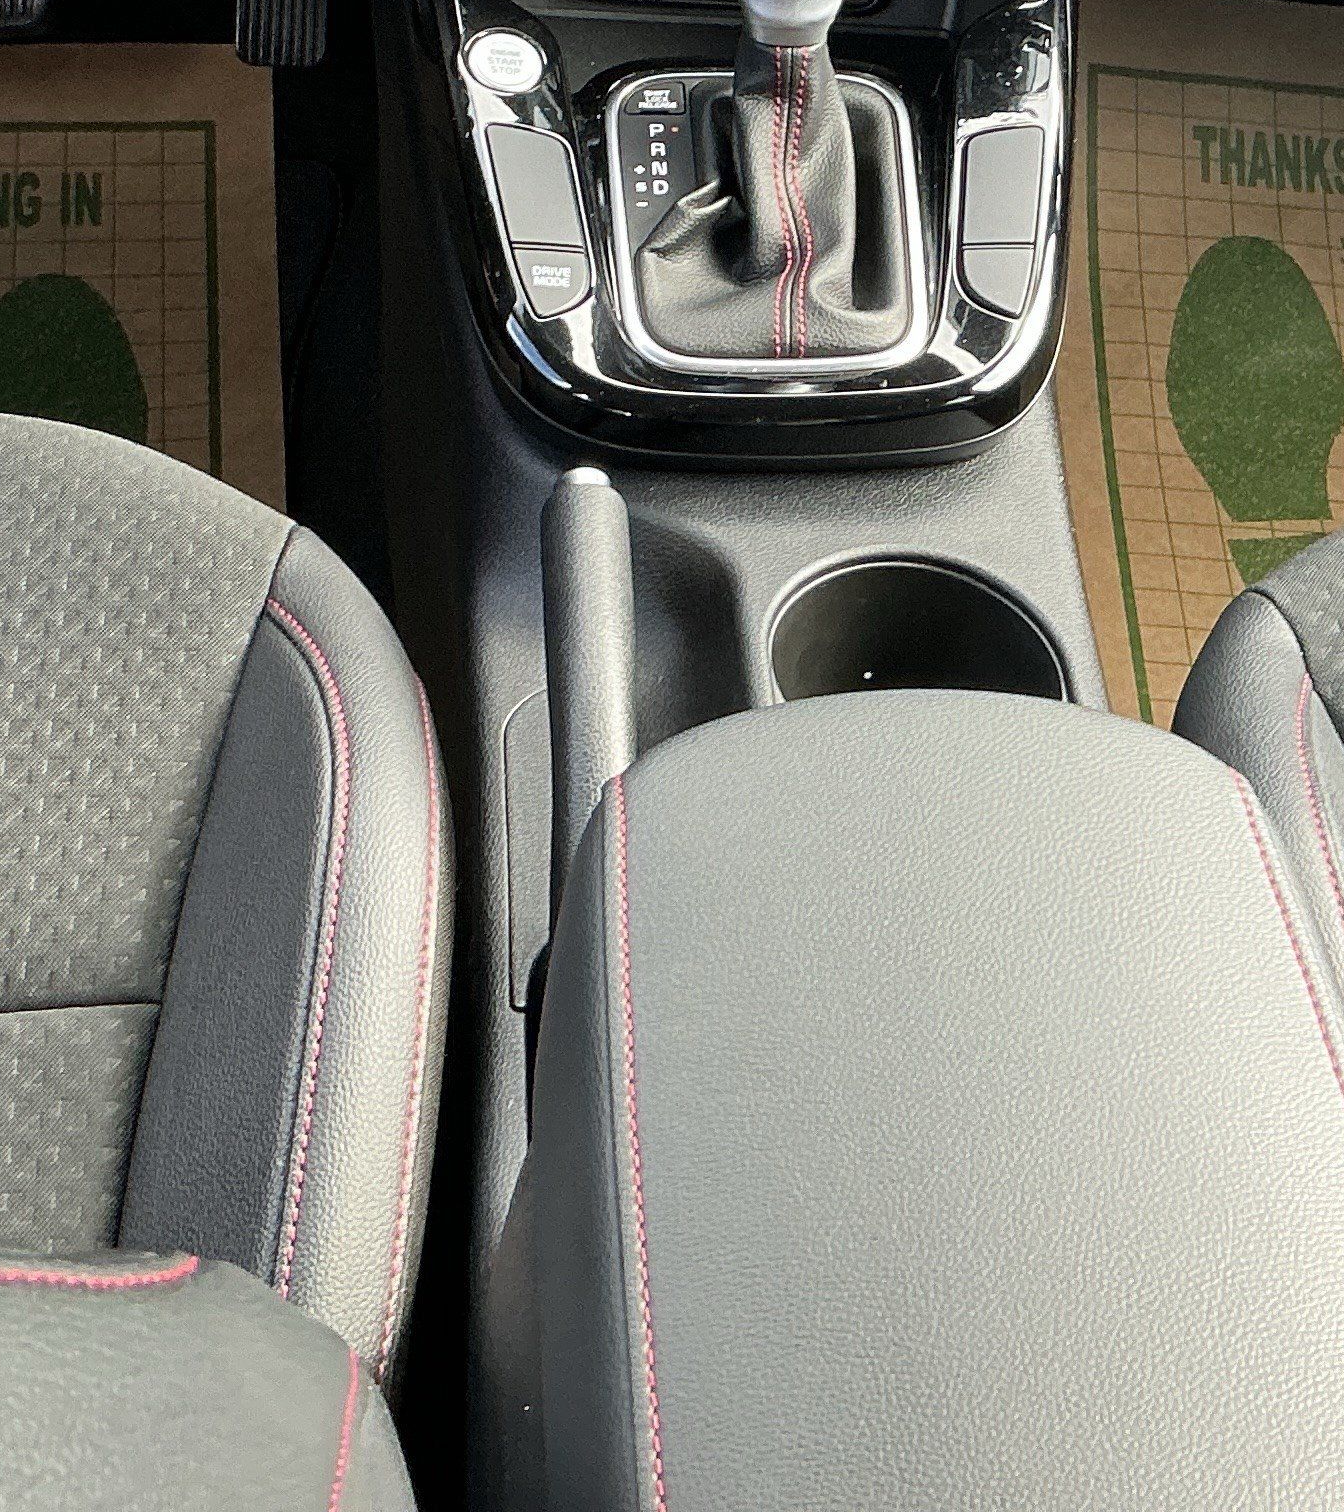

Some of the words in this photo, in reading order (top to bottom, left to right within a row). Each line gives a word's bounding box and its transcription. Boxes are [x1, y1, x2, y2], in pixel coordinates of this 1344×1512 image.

[487, 57, 524, 66] START
[491, 66, 521, 76] STOP
[649, 123, 665, 137] P
[650, 142, 666, 156] R
[651, 161, 668, 176] N
[652, 179, 669, 195] D
[60, 172, 103, 228] IN
[532, 265, 572, 277] DRIVE
[533, 276, 571, 287] MODE
